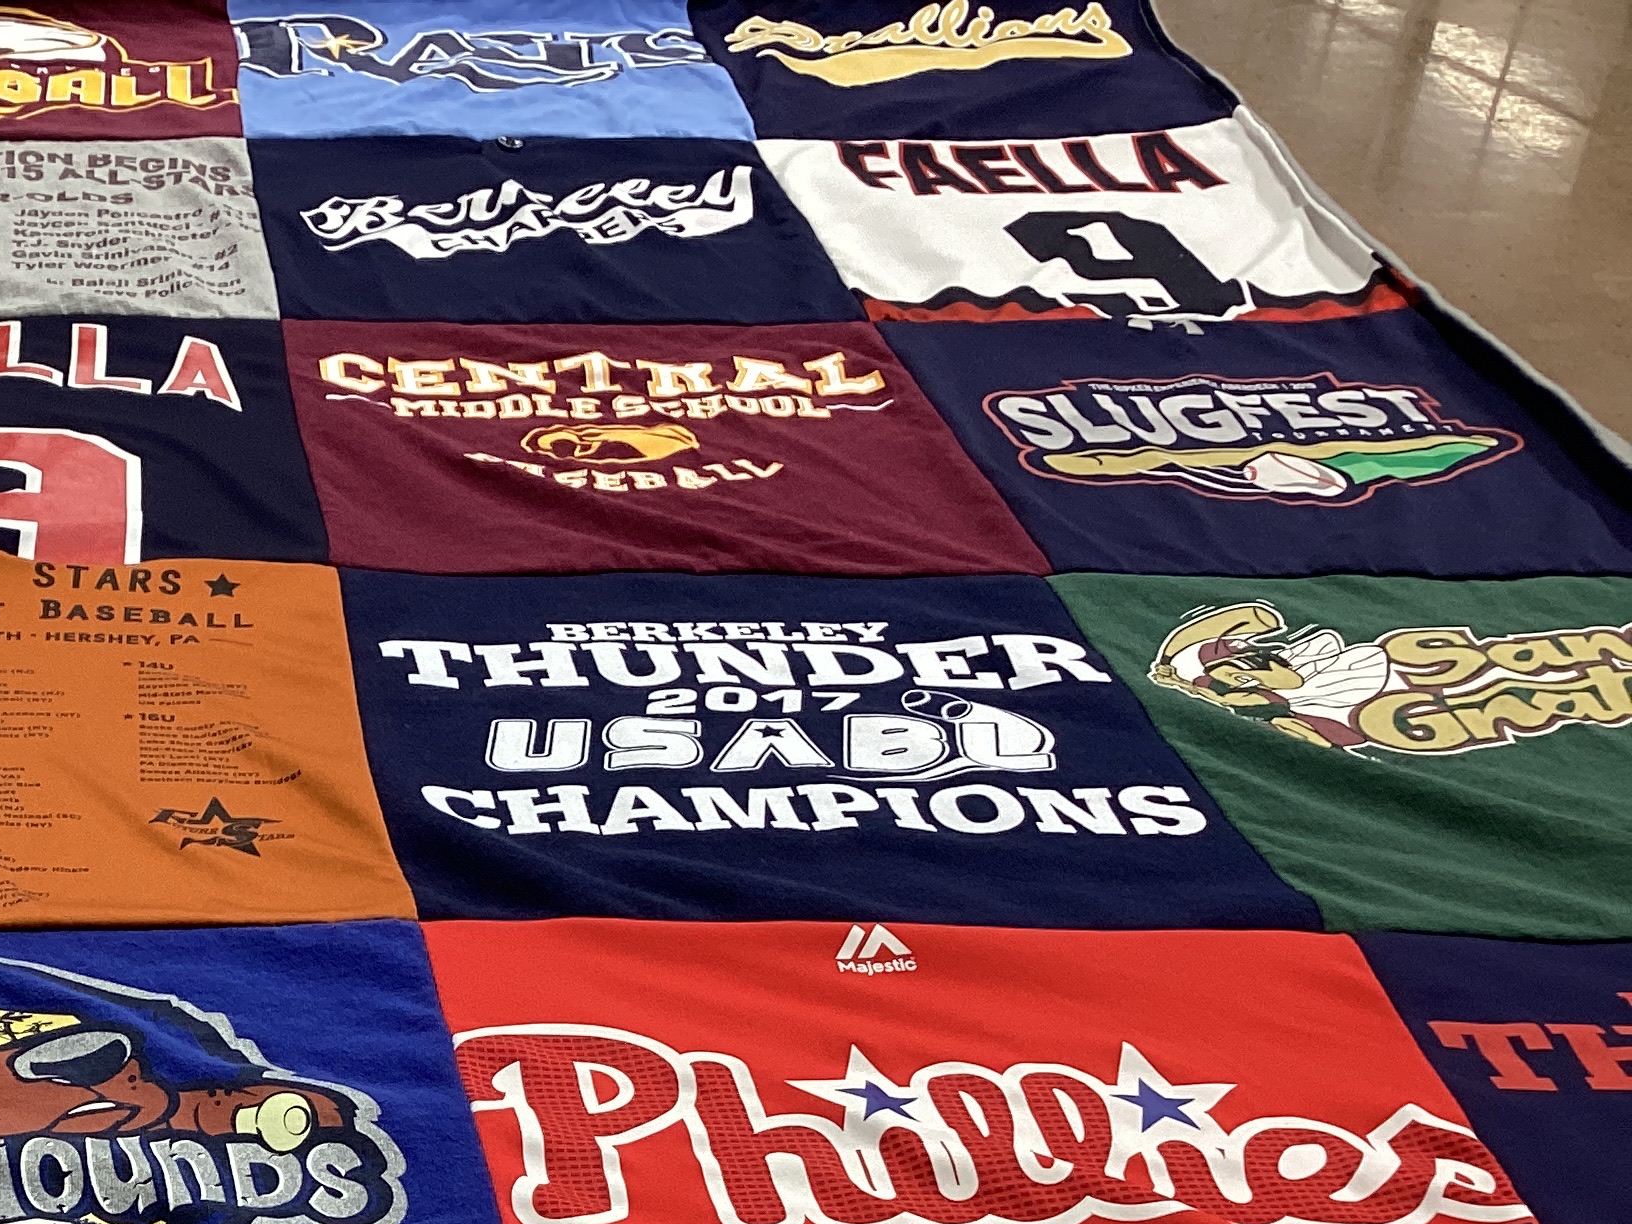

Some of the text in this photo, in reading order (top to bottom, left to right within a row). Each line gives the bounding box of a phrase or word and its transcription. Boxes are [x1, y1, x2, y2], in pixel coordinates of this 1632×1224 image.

[87, 153, 232, 182] BEGINS
[832, 131, 1230, 196] FAELLA
[319, 351, 887, 398] CENTRAL
[391, 394, 832, 419] MIDDLE SCHOOL
[997, 387, 1426, 452] SLUGFEST
[32, 562, 182, 595] STARS
[39, 599, 254, 629] BASEBALL
[170, 634, 201, 645] PA
[546, 622, 888, 643] BERKELEY
[378, 635, 1112, 690] THUNDER
[647, 687, 861, 715] 2017
[420, 783, 1207, 836] CHAMPIONS
[837, 958, 918, 976] Majestic
